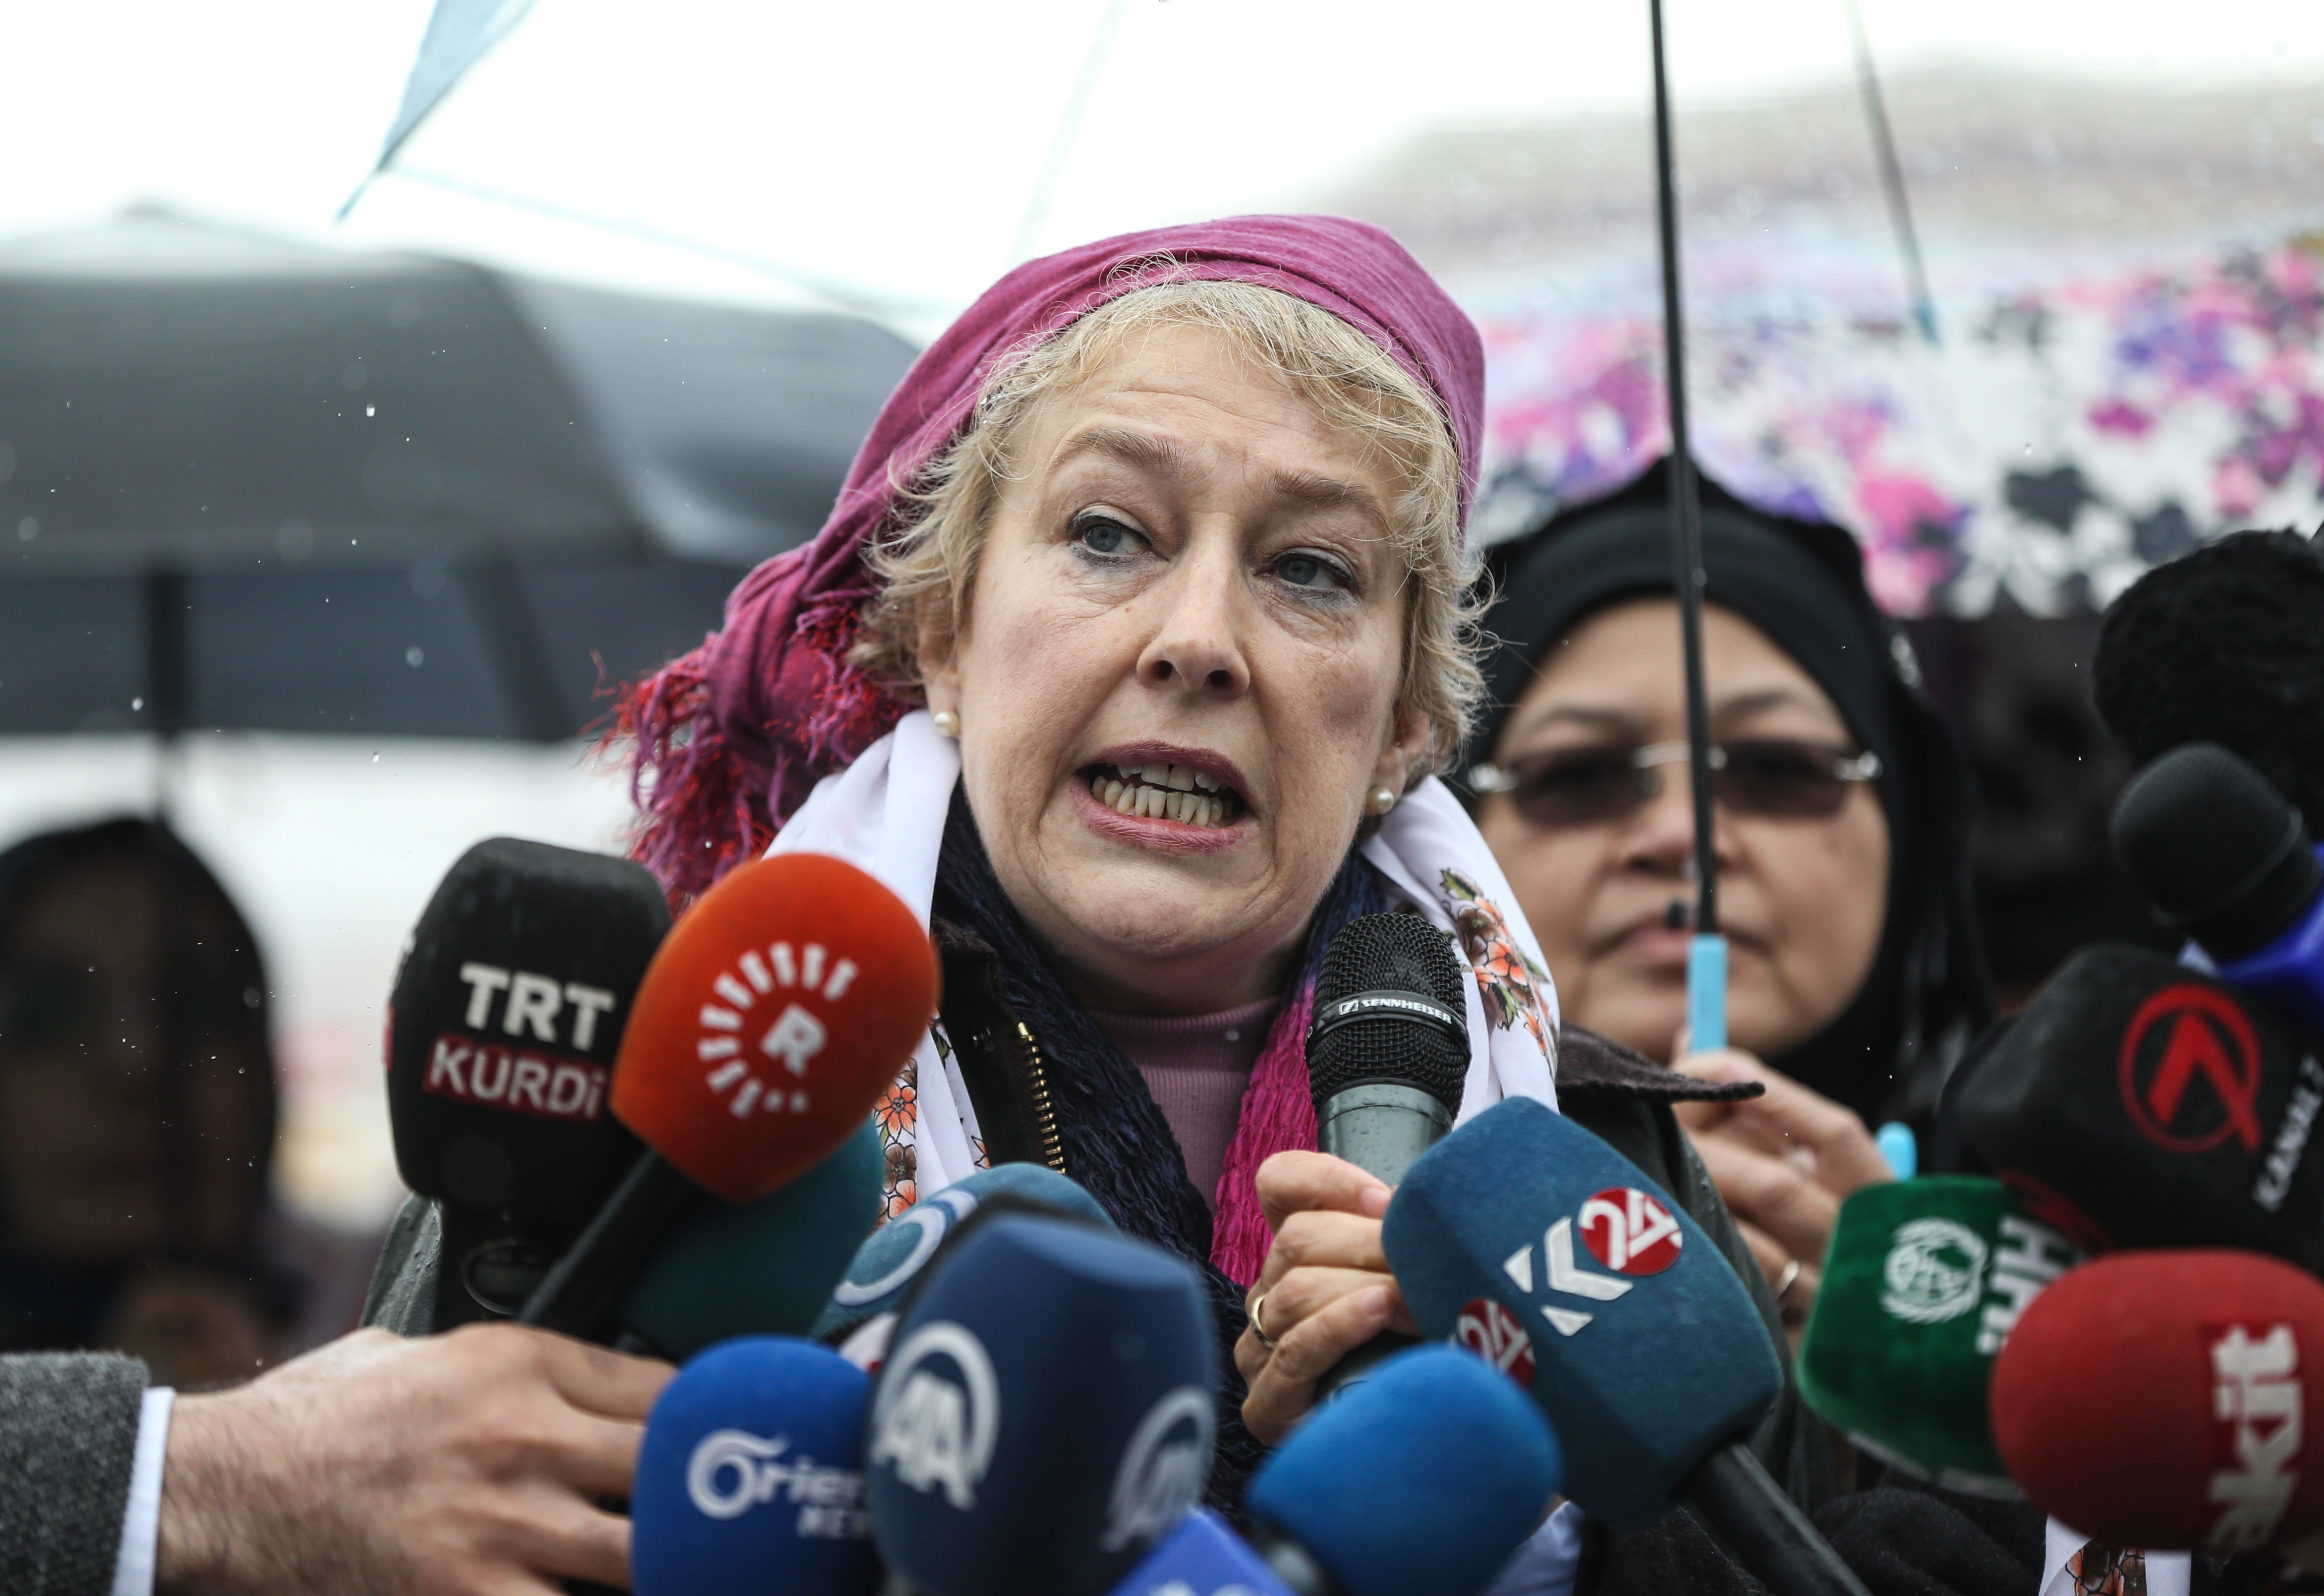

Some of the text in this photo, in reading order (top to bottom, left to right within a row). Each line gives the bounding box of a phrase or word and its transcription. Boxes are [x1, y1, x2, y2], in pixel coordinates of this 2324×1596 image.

[460, 963, 617, 1051] TRT
[761, 1002, 826, 1077] R
[1363, 998, 1452, 1025] SENNHEISER
[1580, 1189, 1683, 1273] 24
